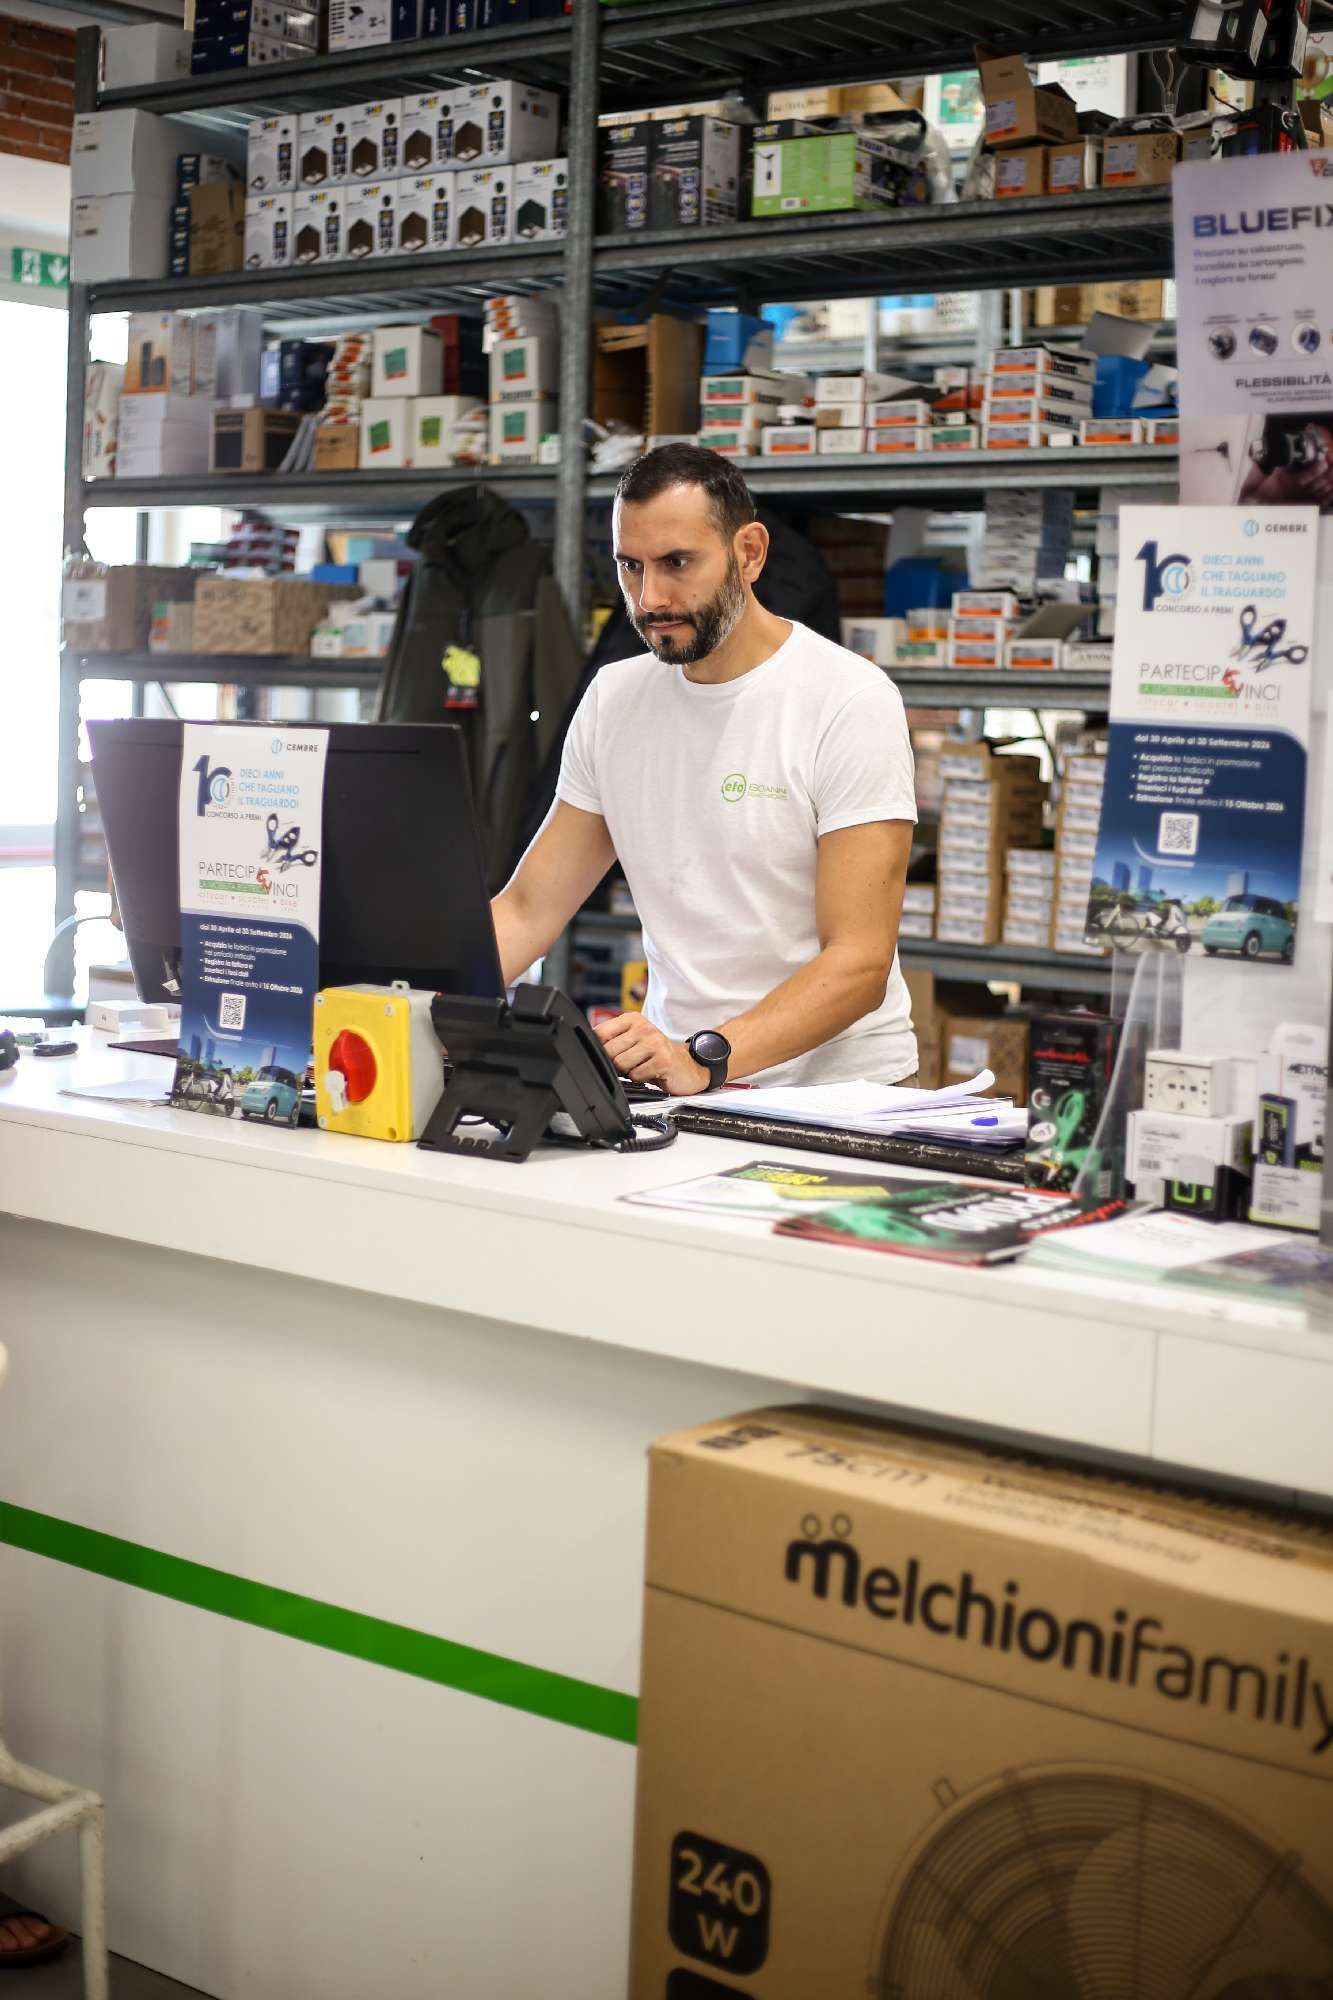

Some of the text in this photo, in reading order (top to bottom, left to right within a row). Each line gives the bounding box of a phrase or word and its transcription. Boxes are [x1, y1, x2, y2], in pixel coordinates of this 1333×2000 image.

[1235, 372, 1332, 389] FLESSIBILITÀ
[1265, 523, 1308, 534] CEMBRE
[1202, 554, 1265, 566] DIECI ANNI
[1201, 571, 1286, 583] CHE TAGLIANO
[1156, 604, 1201, 613] CONCORSO
[286, 743, 319, 752] CEMBRE
[240, 768, 284, 780] DIECI ANNI
[239, 782, 300, 795] CHE TAGLIANO
[206, 811, 239, 819] CONCORSO
[784, 1444, 930, 1487] 75cm
[678, 1849, 761, 1917] 240
[698, 1914, 740, 1959] W
